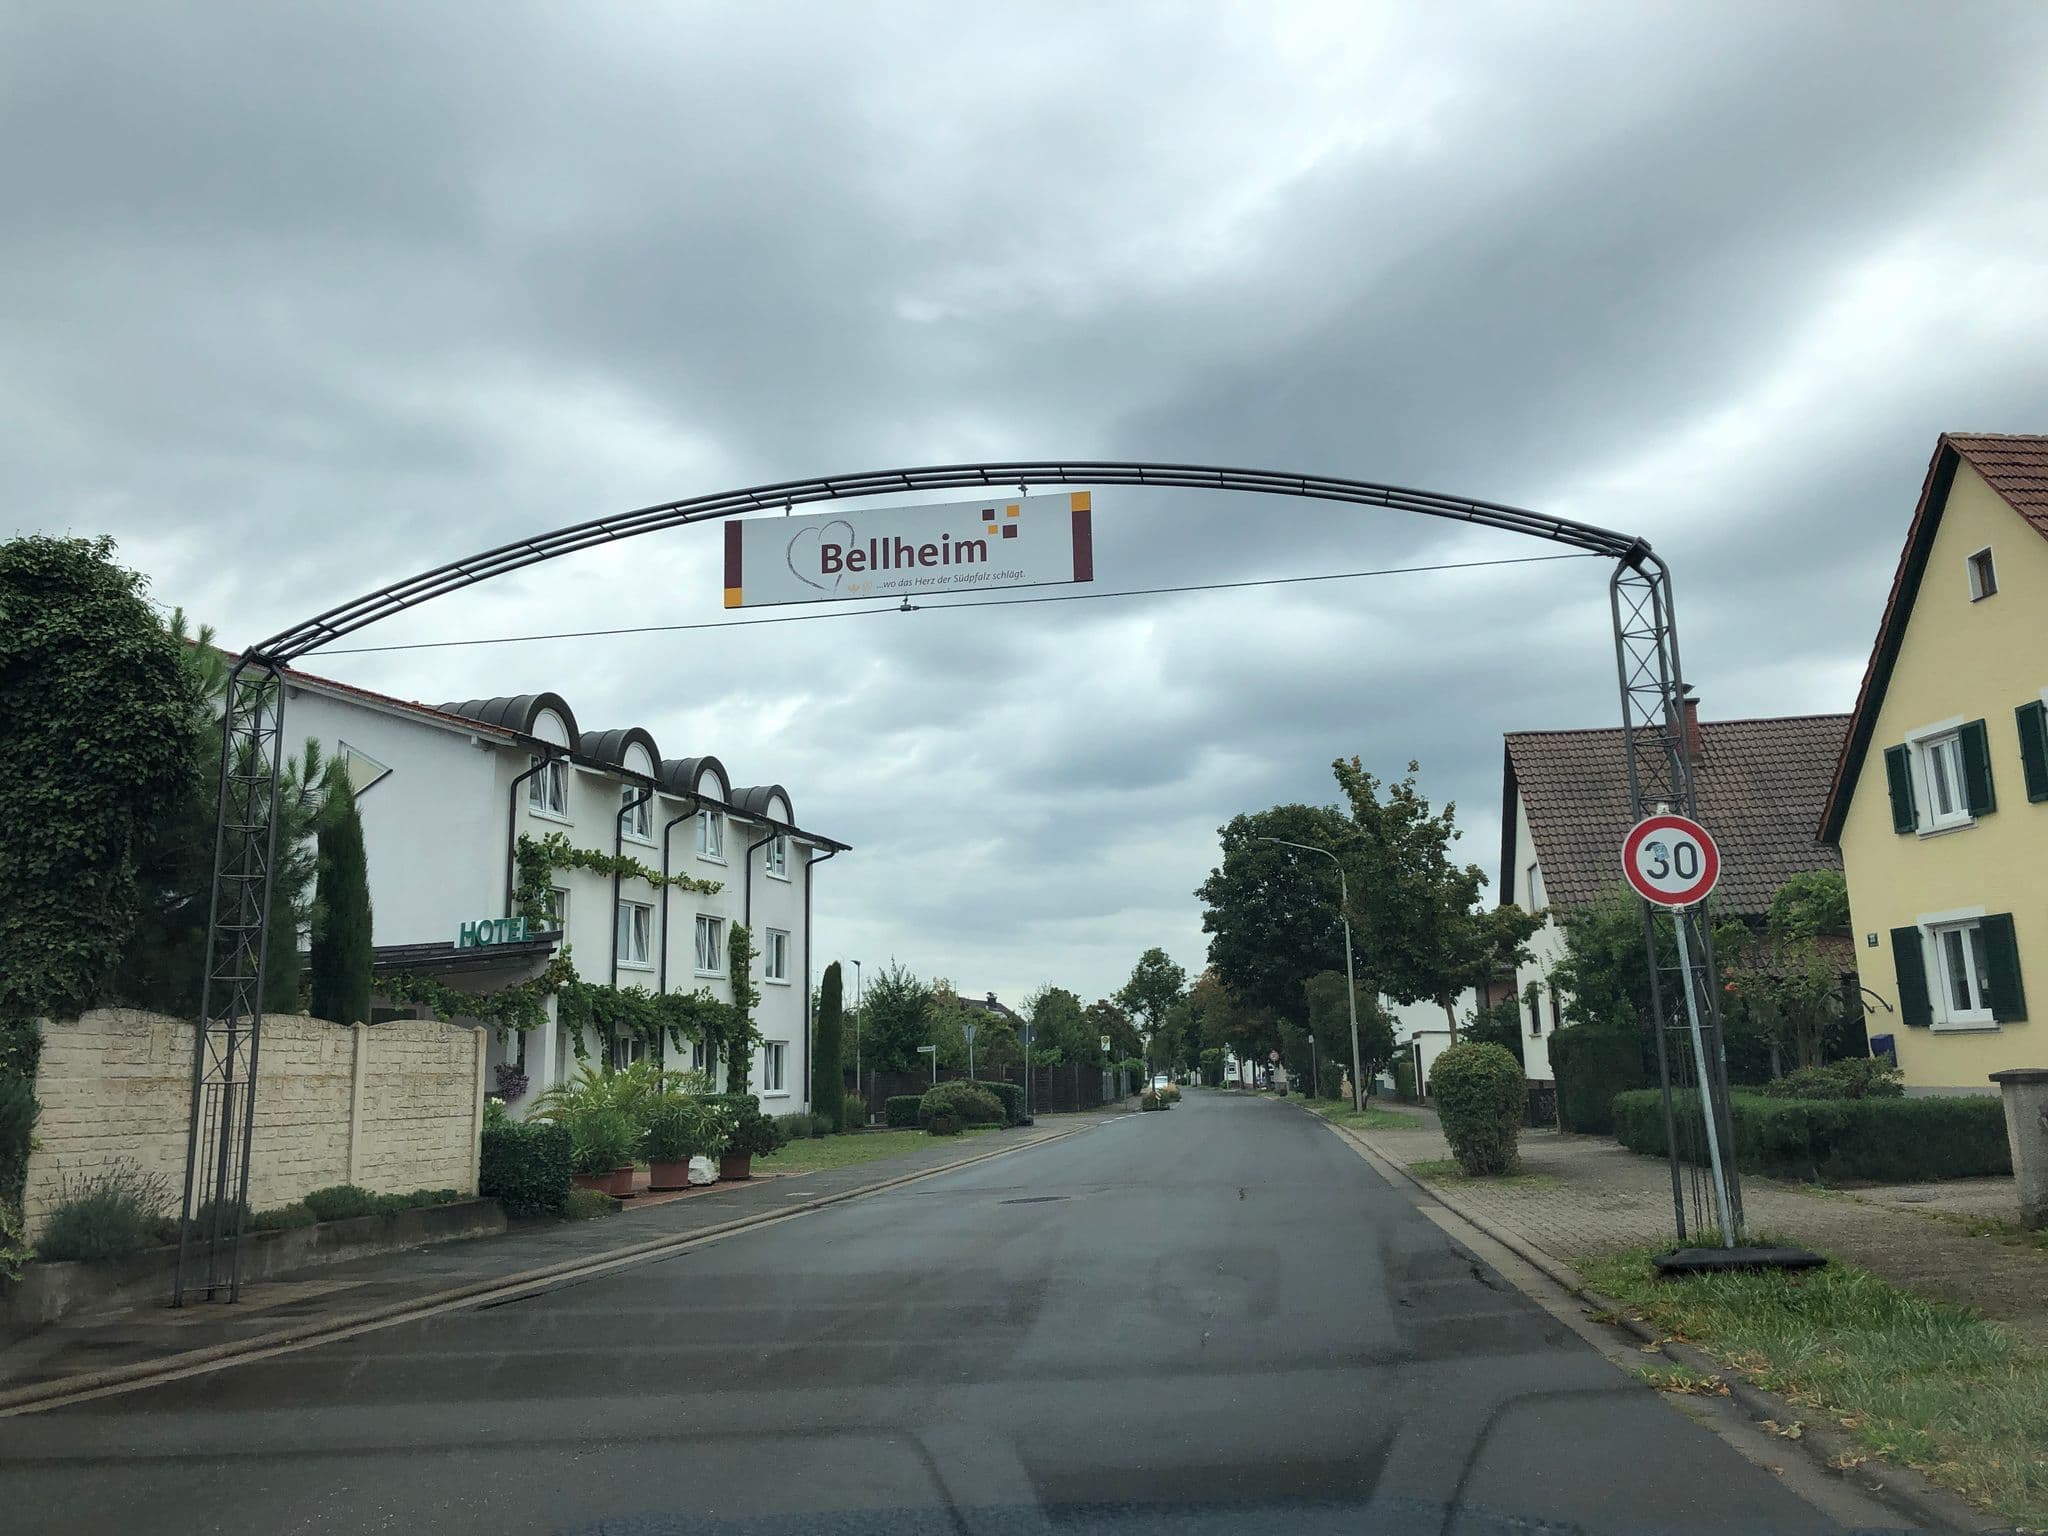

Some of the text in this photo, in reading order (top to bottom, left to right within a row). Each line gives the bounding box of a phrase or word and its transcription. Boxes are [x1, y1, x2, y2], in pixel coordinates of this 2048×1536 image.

[821, 533, 987, 574] Bellheim
[898, 578, 913, 587] das
[915, 577, 936, 586] Herz
[937, 575, 952, 584] der
[953, 572, 991, 584] Südpfalz
[992, 569, 1026, 581] schlägt.
[1645, 841, 1698, 879] 30
[460, 916, 534, 948] HOTEL
